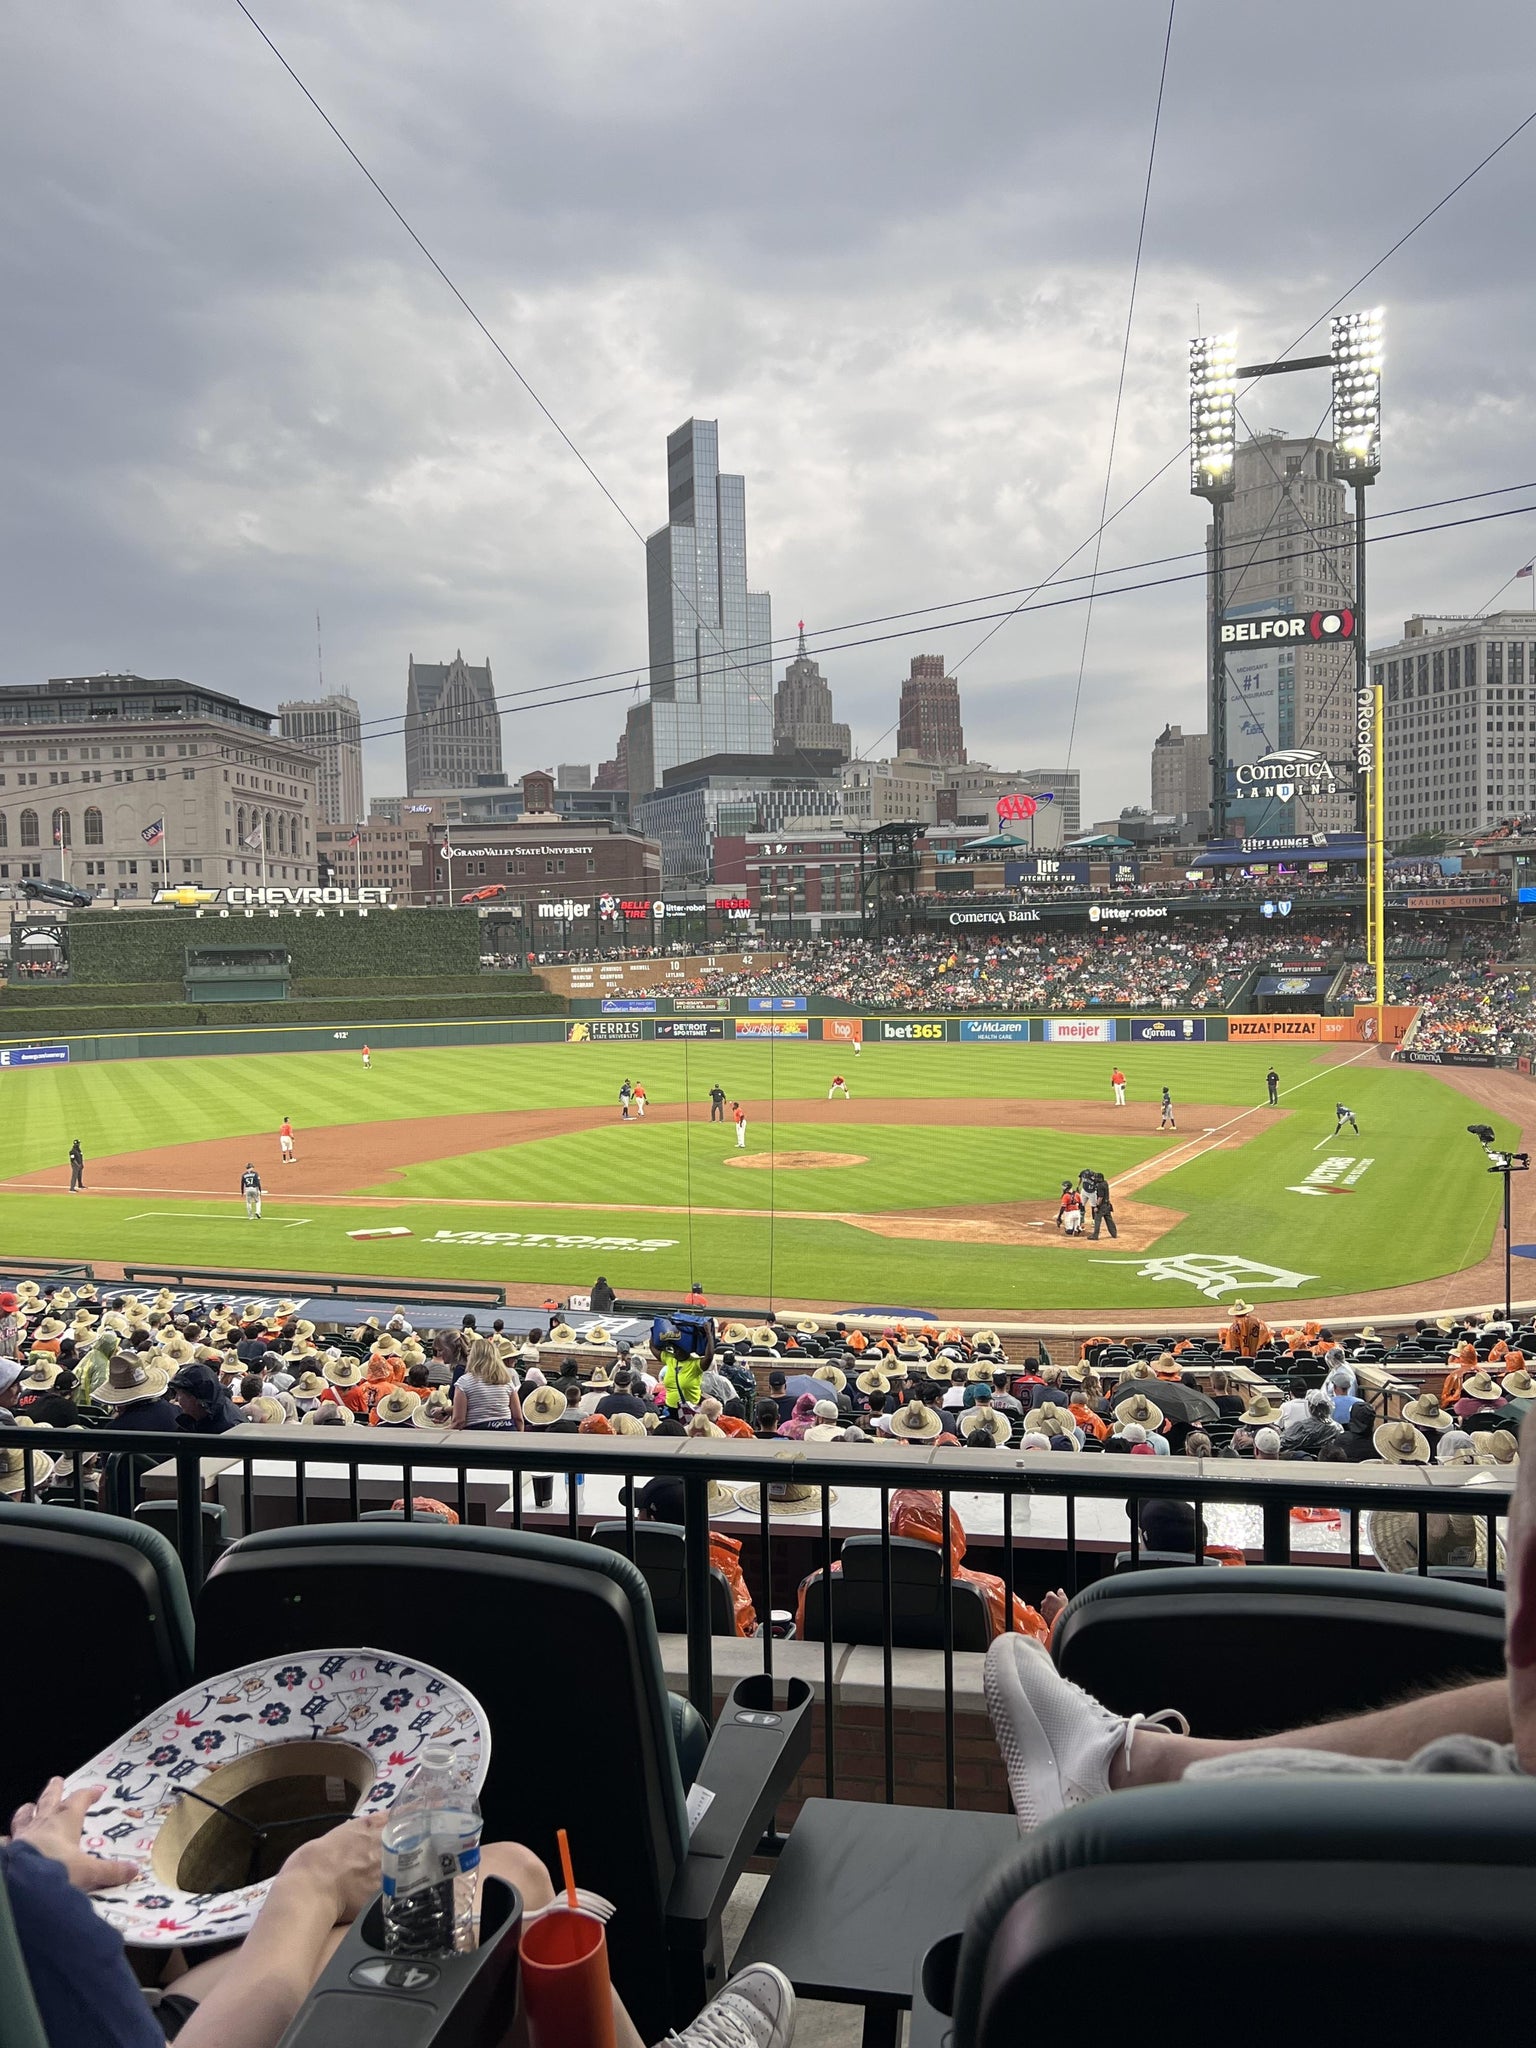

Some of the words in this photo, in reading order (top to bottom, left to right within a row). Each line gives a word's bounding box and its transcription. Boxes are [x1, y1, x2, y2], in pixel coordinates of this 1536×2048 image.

[1221, 618, 1305, 643] BELFOR
[1243, 673, 1260, 691] #1
[1243, 690, 1274, 699] INSURANCE
[1357, 706, 1374, 774] Rocket
[1236, 783, 1337, 800] LANDING
[409, 804, 433, 814] Ashley
[999, 796, 1034, 819] AAA
[1266, 838, 1309, 848] LOUNGE
[454, 848, 486, 857] GRAND
[484, 848, 514, 856] VALLEY
[515, 847, 540, 856] STATE
[542, 846, 593, 855] UNIVERSITY
[1036, 859, 1060, 876] Lite
[1118, 865, 1132, 875] Lite
[226, 887, 392, 904] CHEVROLET
[1459, 896, 1498, 904] CORNER
[538, 900, 590, 921] meijer
[620, 901, 650, 910] BELLE
[666, 904, 706, 912] litter-robot
[196, 908, 368, 918] FOUNTAIN
[624, 910, 646, 918] TIRE
[728, 909, 751, 920] LAW
[1008, 909, 1040, 922] Bank
[1101, 906, 1168, 919] litter-robot
[670, 961, 680, 970] 10
[708, 958, 716, 966] 11
[742, 956, 753, 964] 42
[592, 1022, 639, 1034] FERRIS
[741, 1022, 780, 1035] Surfside
[834, 1022, 850, 1038] hap
[884, 1023, 942, 1038] bet365
[982, 1022, 1022, 1032] McLaren
[1058, 1022, 1100, 1039] meijer
[1230, 1023, 1270, 1034] PIZZA!
[1273, 1022, 1316, 1034] PIZZA!
[1142, 1027, 1176, 1040] Corona
[0, 1051, 10, 1066] E
[433, 1230, 680, 1248] VICTORS
[502, 1241, 659, 1252] SOLUTIONS
[762, 1716, 776, 1724] 4
[402, 1968, 429, 1988] 4
